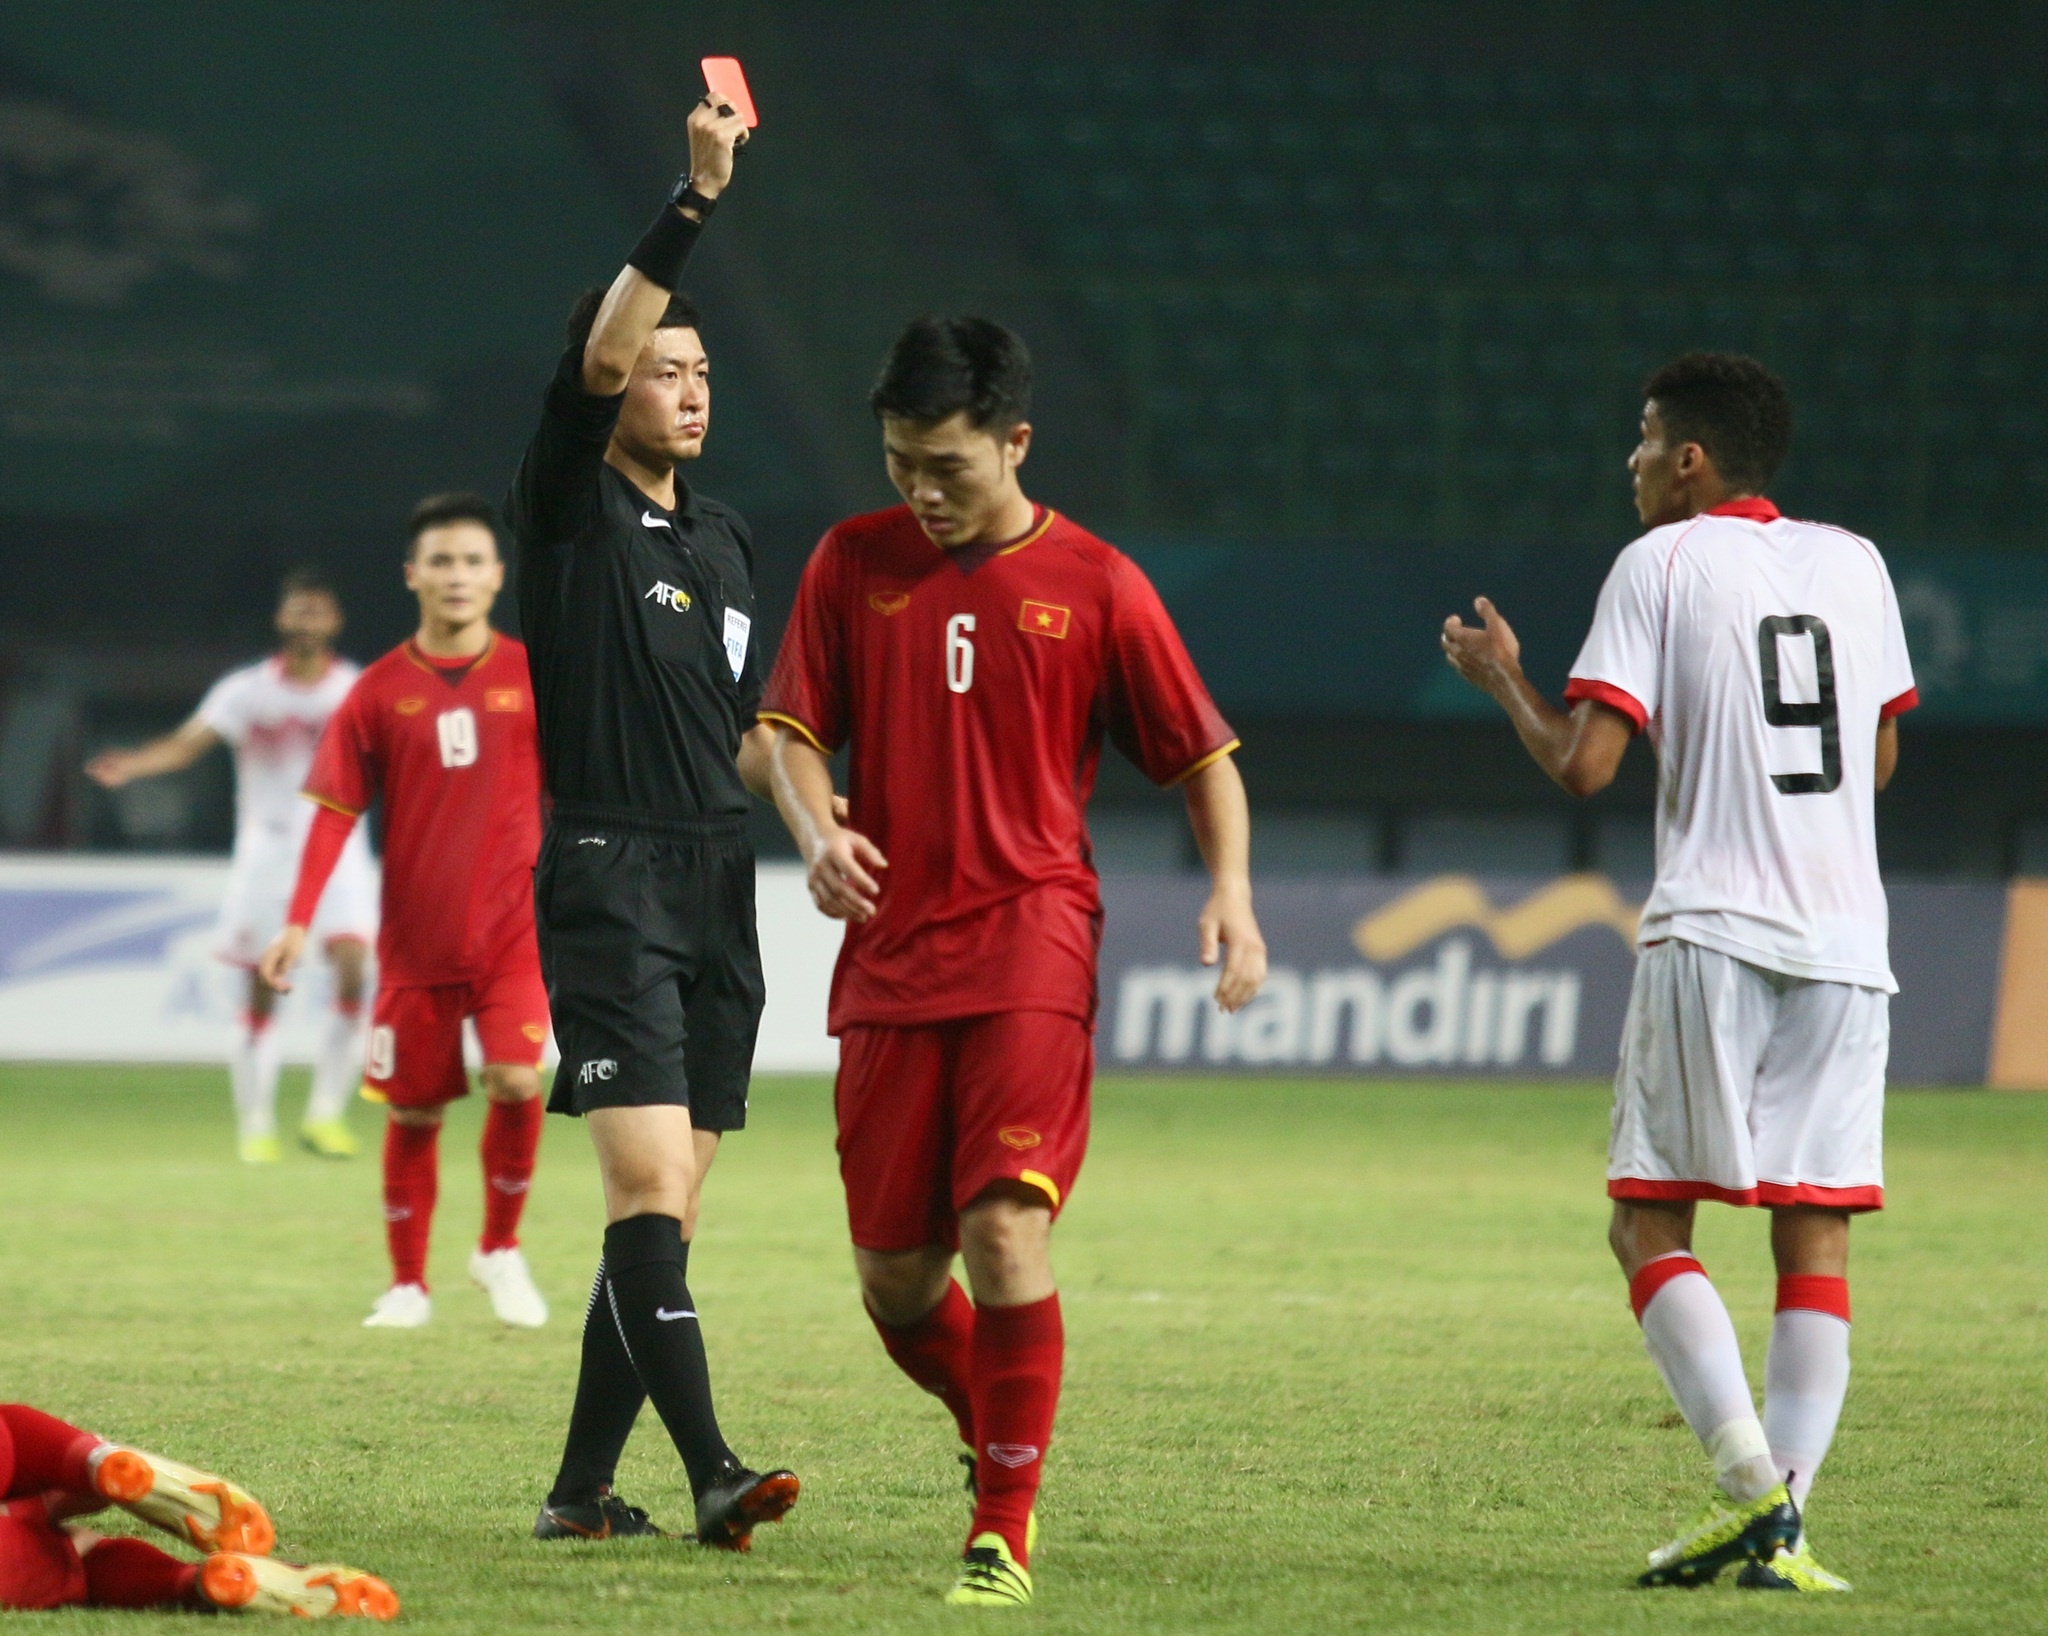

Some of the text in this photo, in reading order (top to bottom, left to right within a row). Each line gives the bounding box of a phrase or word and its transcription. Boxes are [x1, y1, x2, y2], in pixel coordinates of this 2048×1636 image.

[645, 580, 691, 612] AFC
[726, 637, 743, 659] FIFA
[946, 613, 976, 694] 6
[1758, 614, 1842, 794] 9
[437, 706, 478, 768] 19
[1112, 938, 1581, 1066] mandiri
[578, 1058, 618, 1086] AFC
